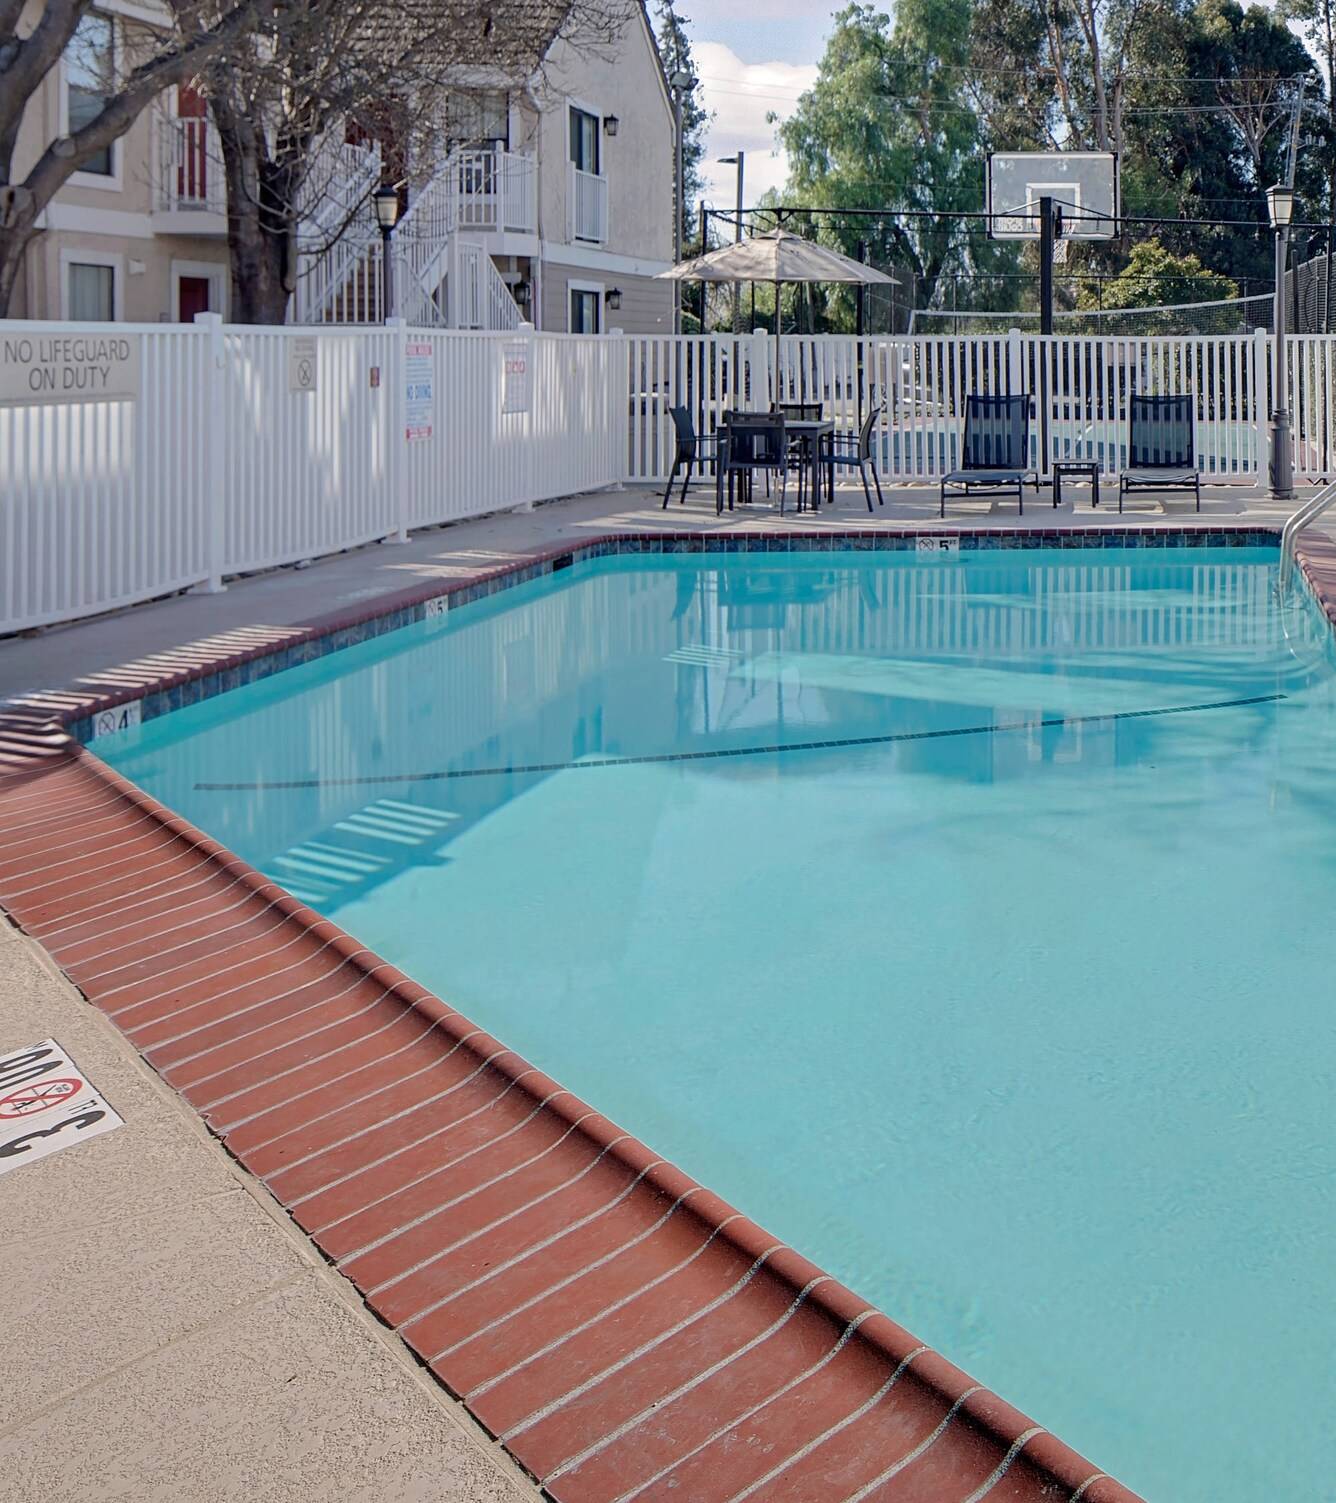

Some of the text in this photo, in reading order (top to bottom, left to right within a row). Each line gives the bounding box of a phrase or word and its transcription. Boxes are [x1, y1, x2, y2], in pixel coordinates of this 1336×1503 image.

[4, 339, 130, 363] NO LIFEGUARD
[28, 366, 111, 391] ON DUTY
[939, 540, 949, 551] 5
